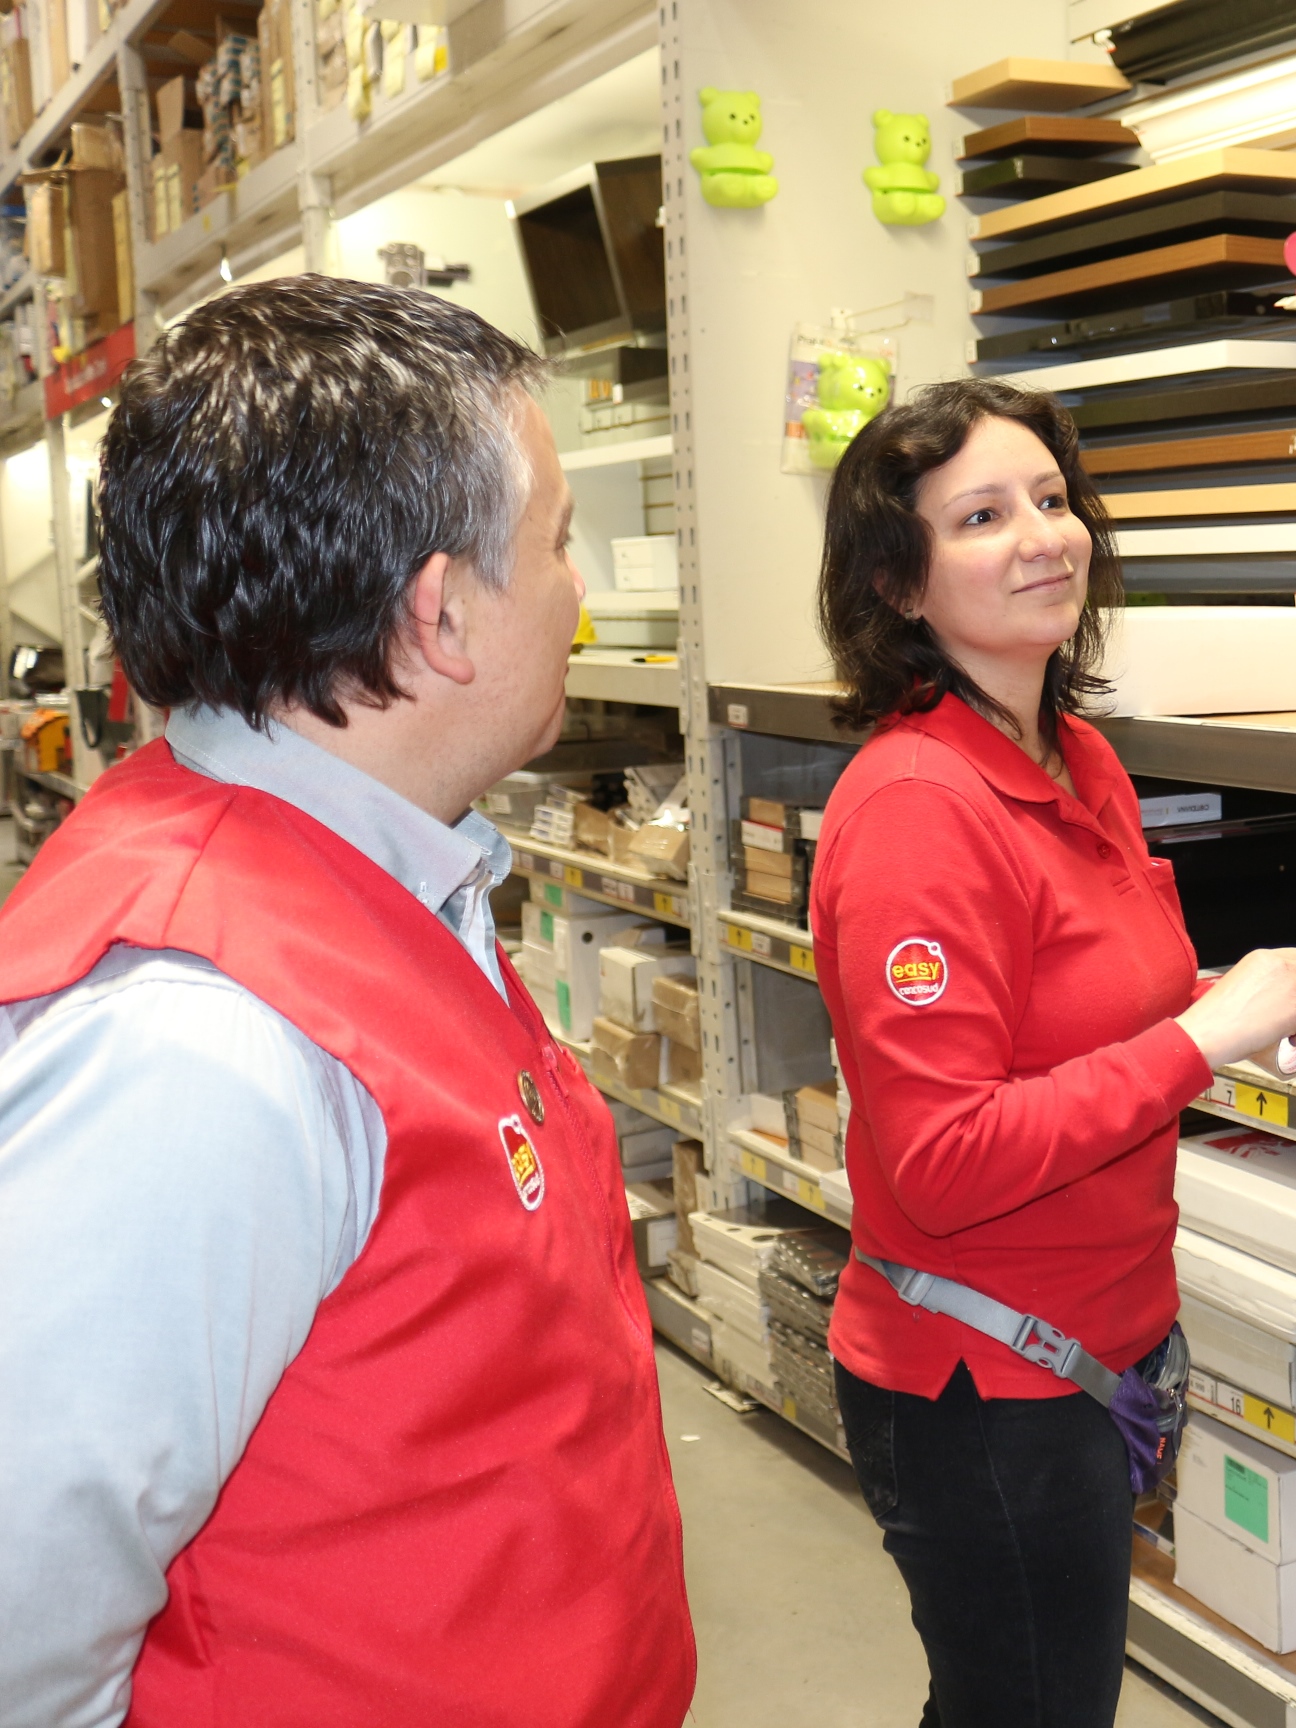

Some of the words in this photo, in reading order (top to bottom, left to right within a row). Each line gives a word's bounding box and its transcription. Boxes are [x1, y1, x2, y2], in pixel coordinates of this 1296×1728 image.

[892, 962, 939, 980] easy
[1226, 1089, 1232, 1105] 7
[1231, 1396, 1241, 1415] 16
